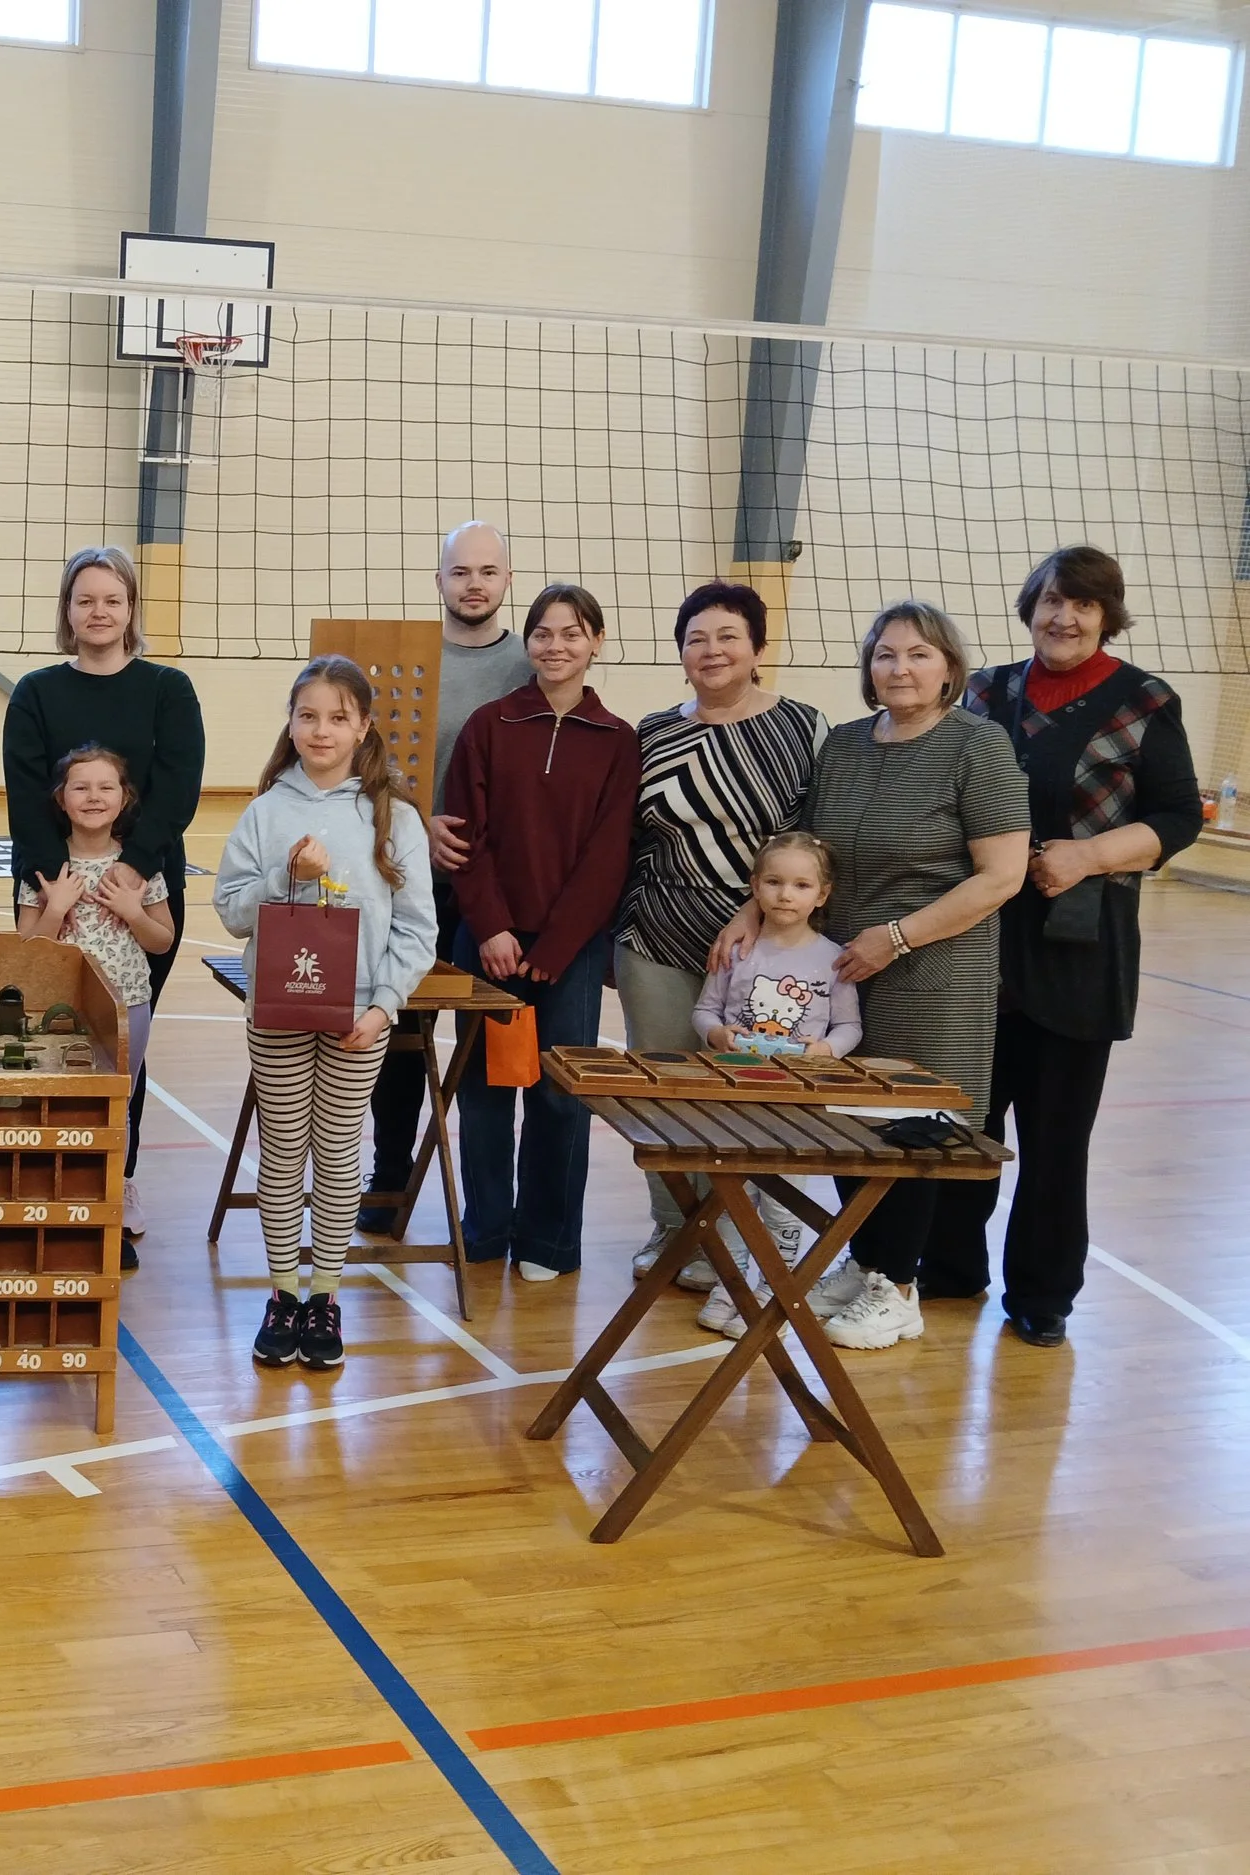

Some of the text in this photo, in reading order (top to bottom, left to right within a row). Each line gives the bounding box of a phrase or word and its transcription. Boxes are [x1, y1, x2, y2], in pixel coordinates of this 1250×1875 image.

[56, 1130, 94, 1146] 200
[23, 1206, 48, 1222] 20
[67, 1205, 90, 1222] 70
[53, 1280, 90, 1296] 500
[16, 1353, 42, 1370] 40
[62, 1352, 87, 1369] 90
